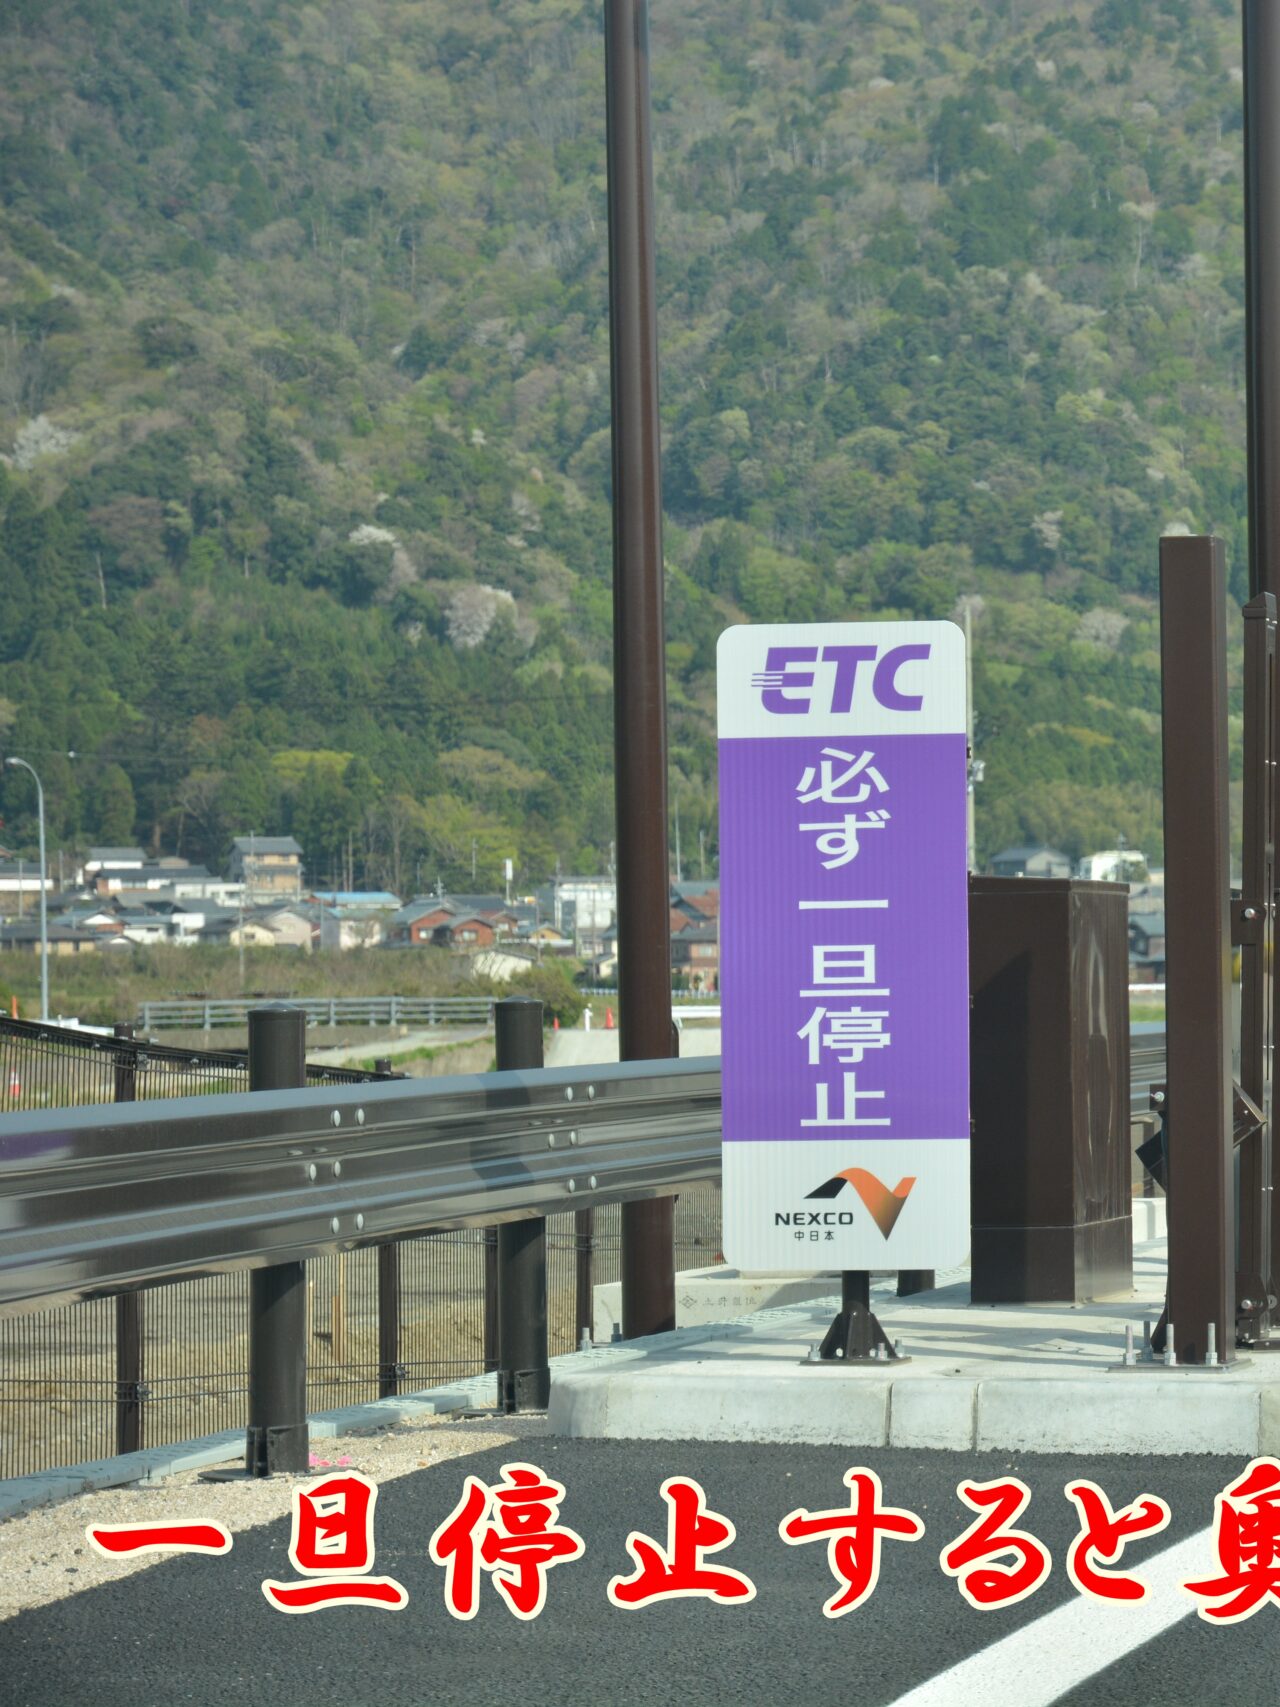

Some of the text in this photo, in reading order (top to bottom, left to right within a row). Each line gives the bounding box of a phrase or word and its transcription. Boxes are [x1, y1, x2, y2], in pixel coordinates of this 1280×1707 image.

[751, 643, 931, 715] ETC
[795, 746, 892, 1128] 必ず一旦停止
[775, 1212, 854, 1226] NEXCO
[794, 1230, 835, 1241] 中日本
